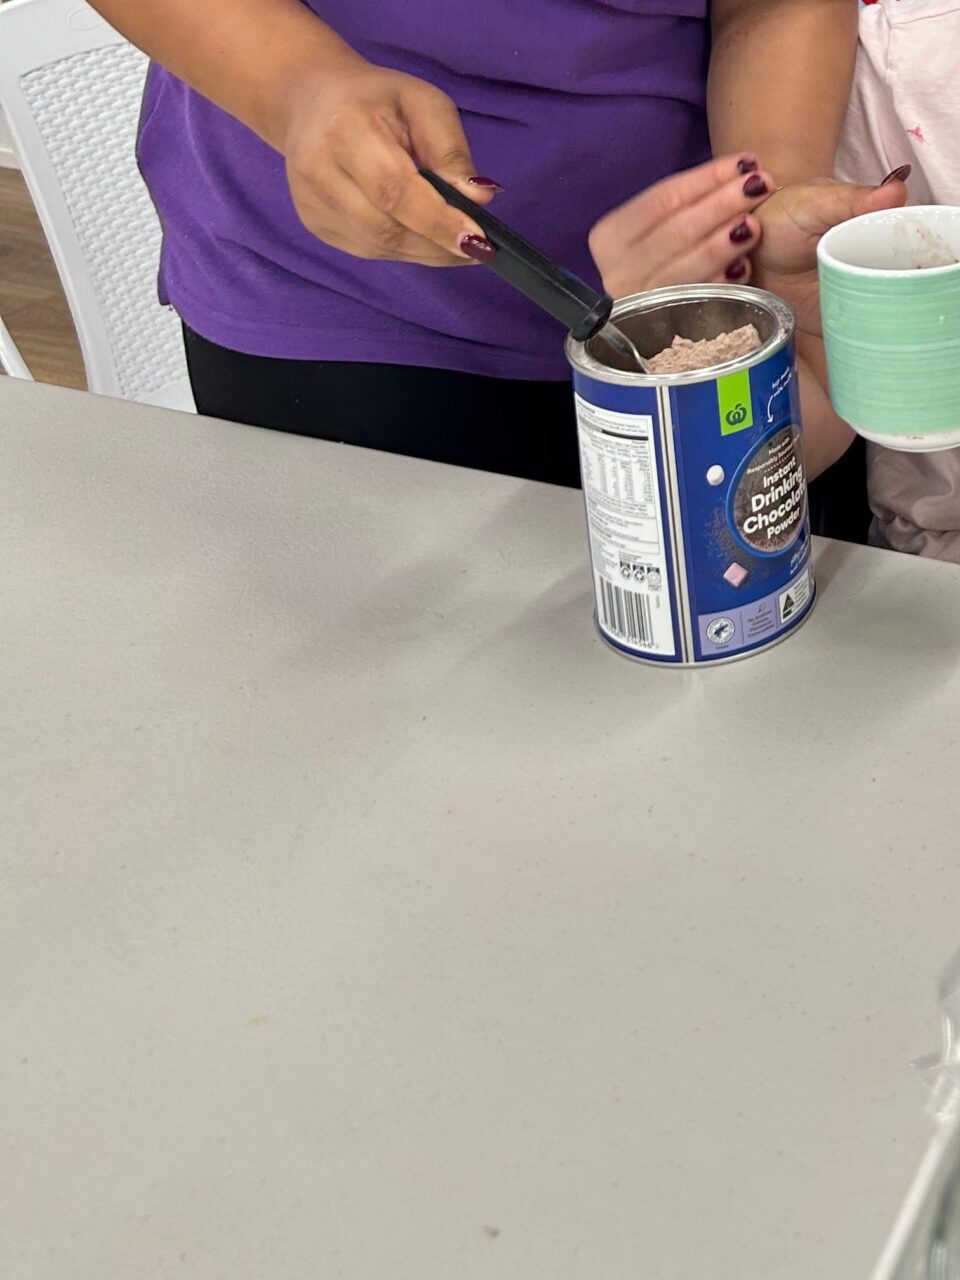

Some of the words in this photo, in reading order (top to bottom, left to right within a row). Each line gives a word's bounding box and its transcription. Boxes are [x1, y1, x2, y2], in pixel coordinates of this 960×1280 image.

[751, 464, 803, 513] Drinking
[763, 456, 797, 489] Instant
[743, 478, 806, 534] Chocolat
[766, 507, 800, 540] Powder
